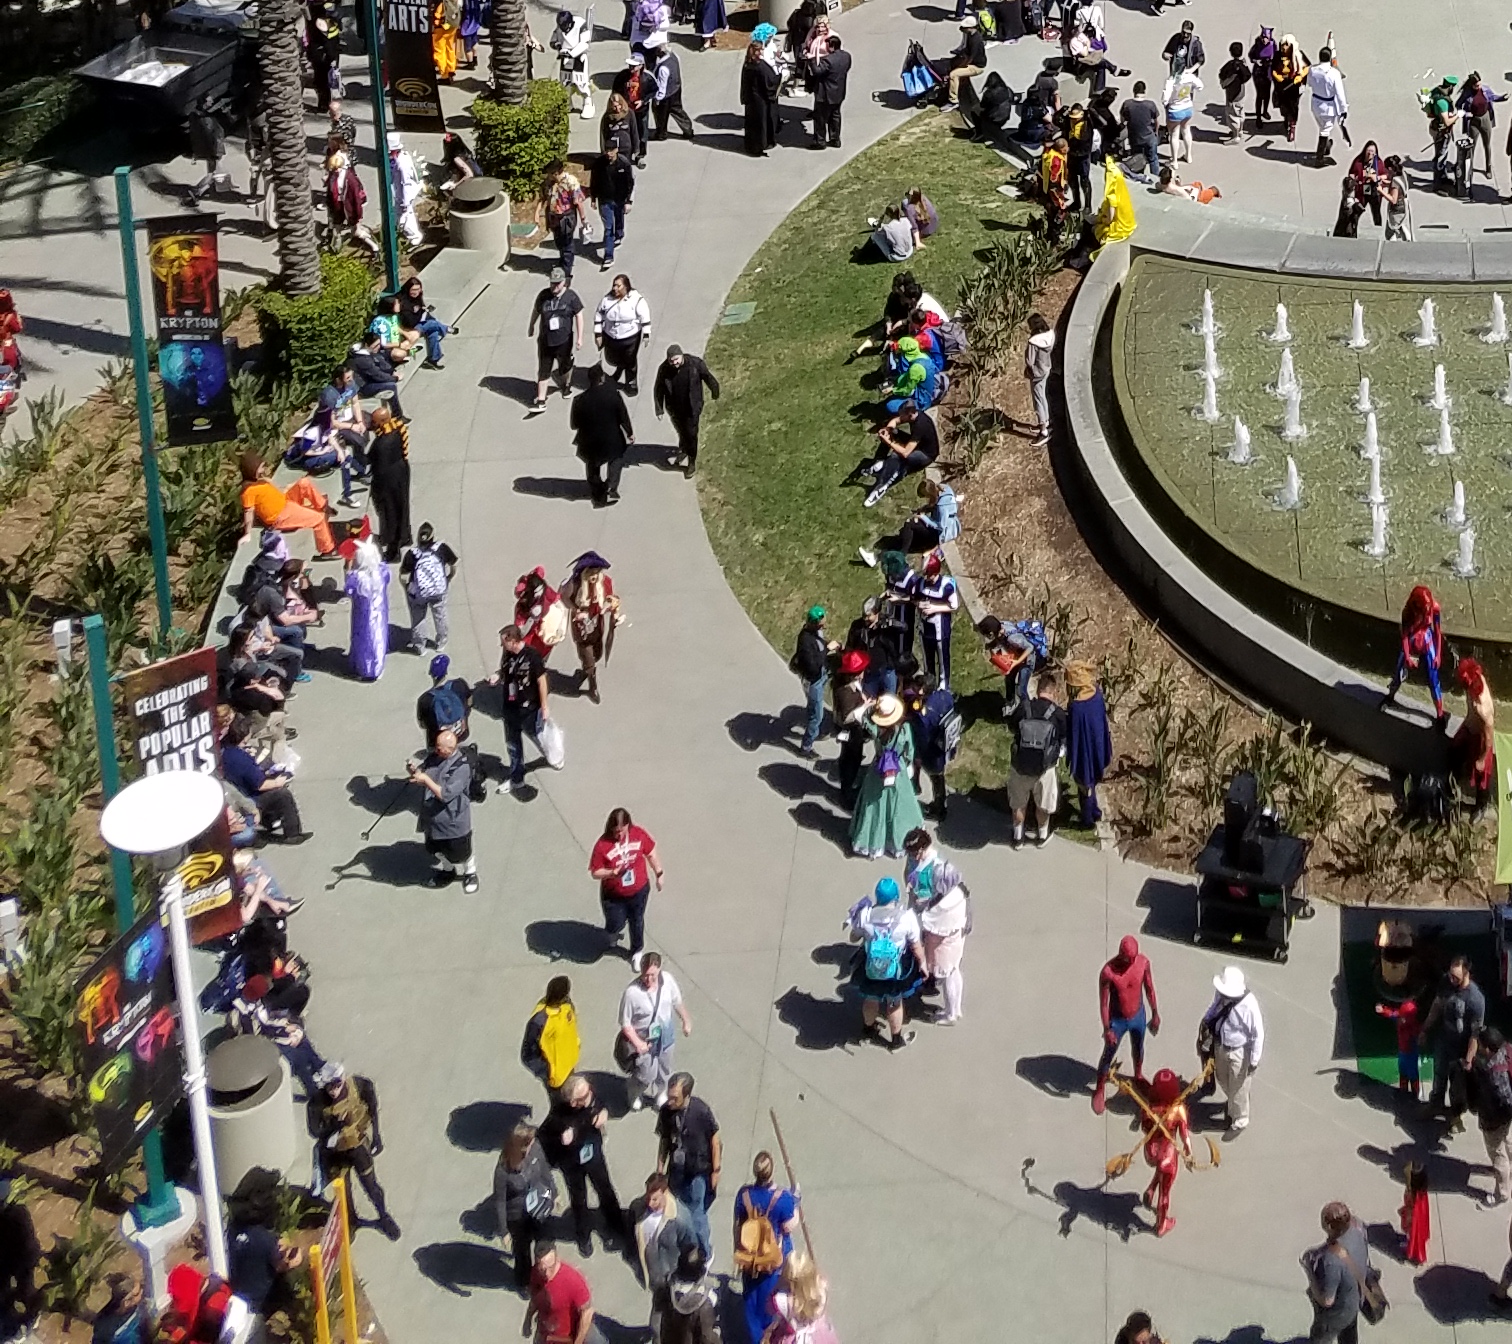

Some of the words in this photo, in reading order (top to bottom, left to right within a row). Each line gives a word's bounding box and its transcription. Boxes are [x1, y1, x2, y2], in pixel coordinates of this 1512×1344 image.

[388, 3, 429, 34] ARTS
[160, 316, 219, 329] KRYPTON
[134, 674, 209, 717] CELEBRATING
[161, 702, 187, 728] THE
[138, 711, 212, 761] POPULAR
